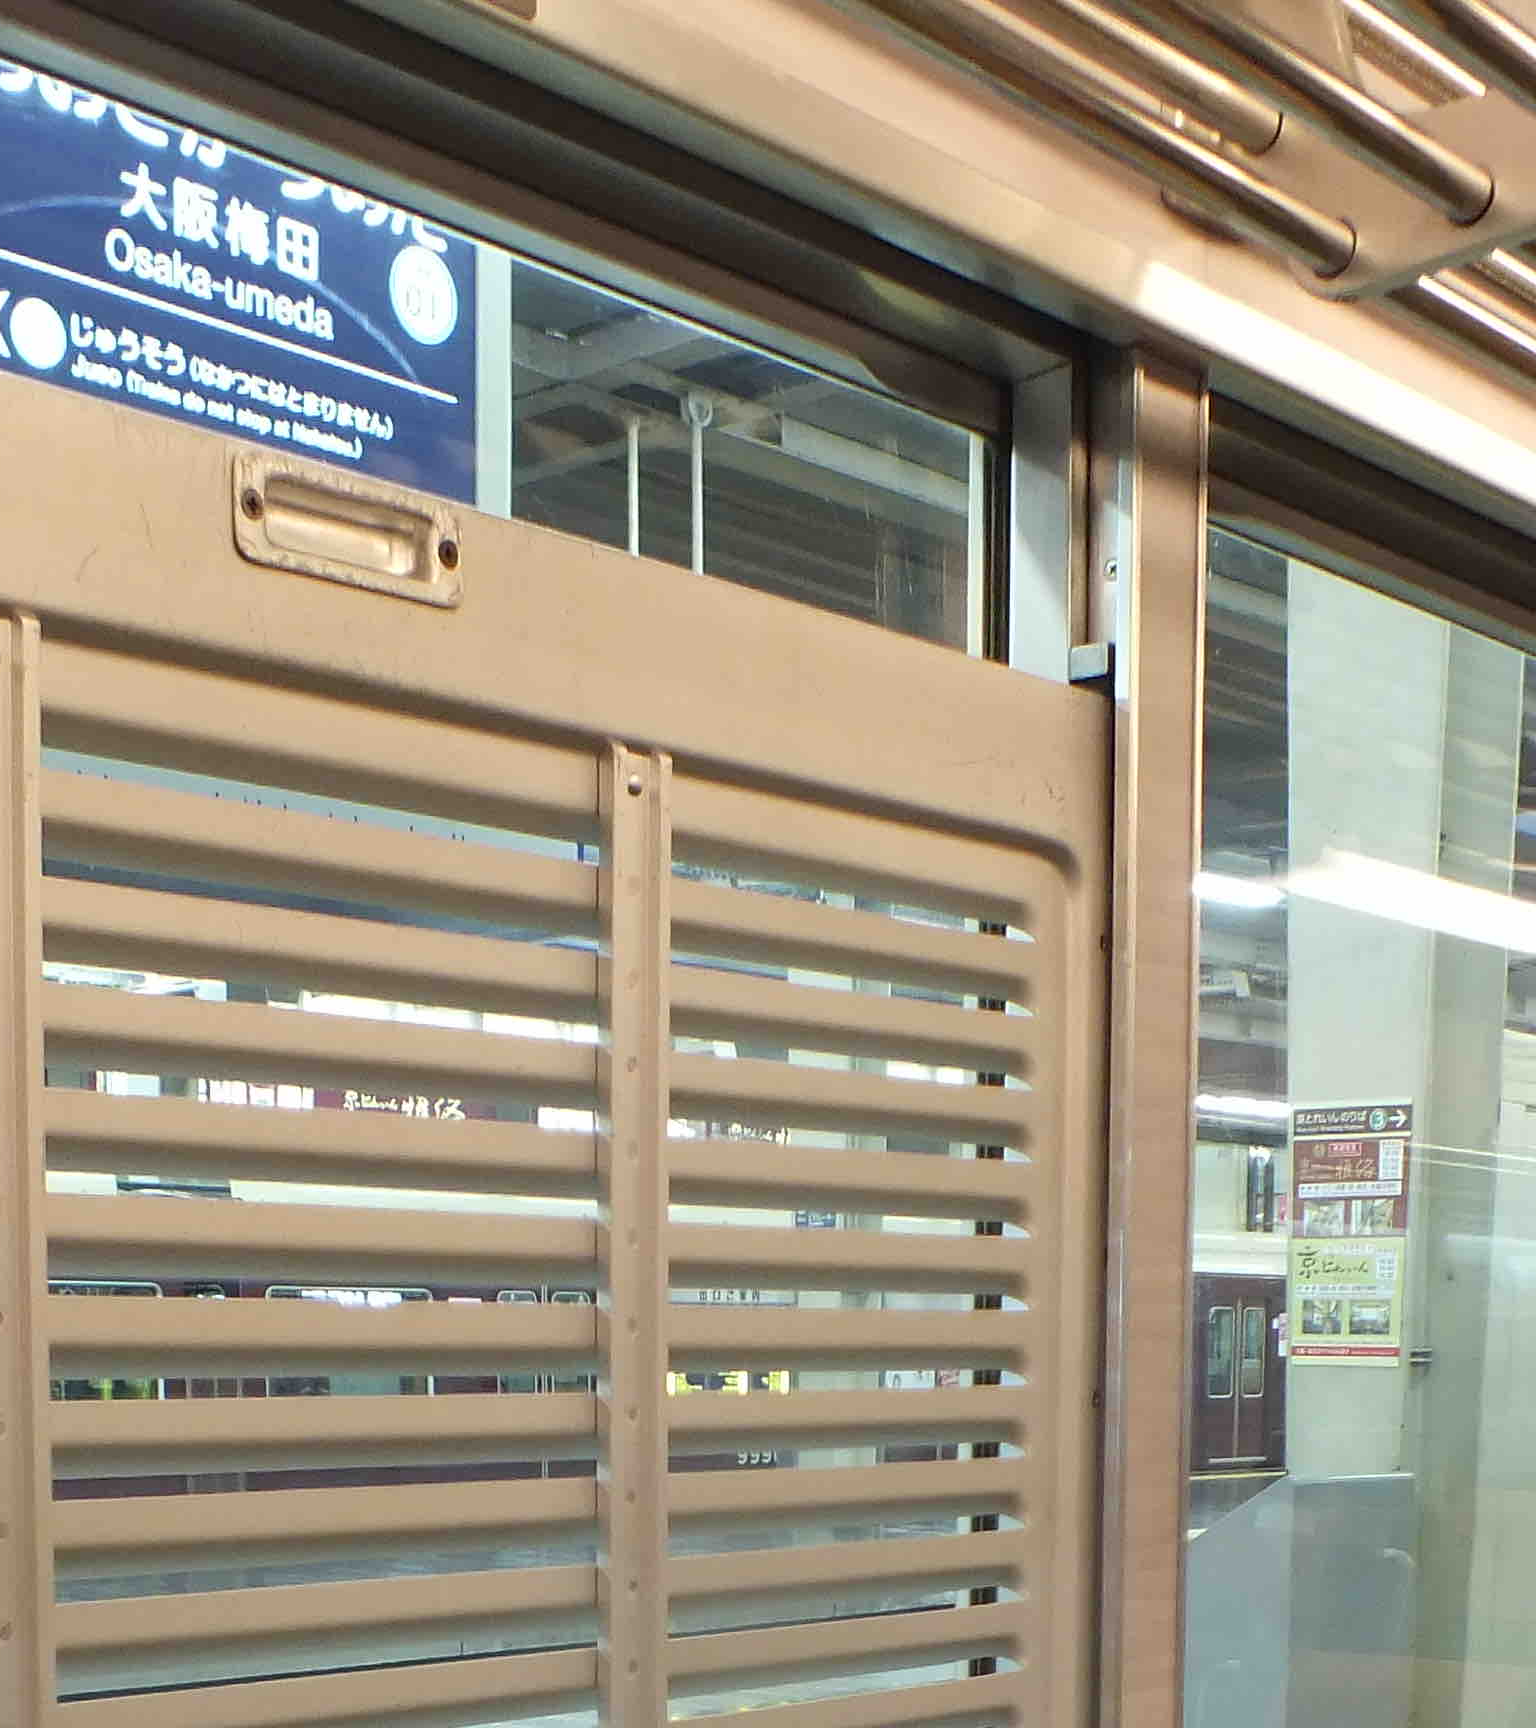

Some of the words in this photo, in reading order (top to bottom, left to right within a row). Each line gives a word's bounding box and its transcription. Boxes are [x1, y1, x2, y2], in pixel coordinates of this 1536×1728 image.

[119, 161, 319, 281] 大阪梅田
[105, 228, 334, 342] Osaka-umeda
[70, 312, 186, 377] じゅうそう
